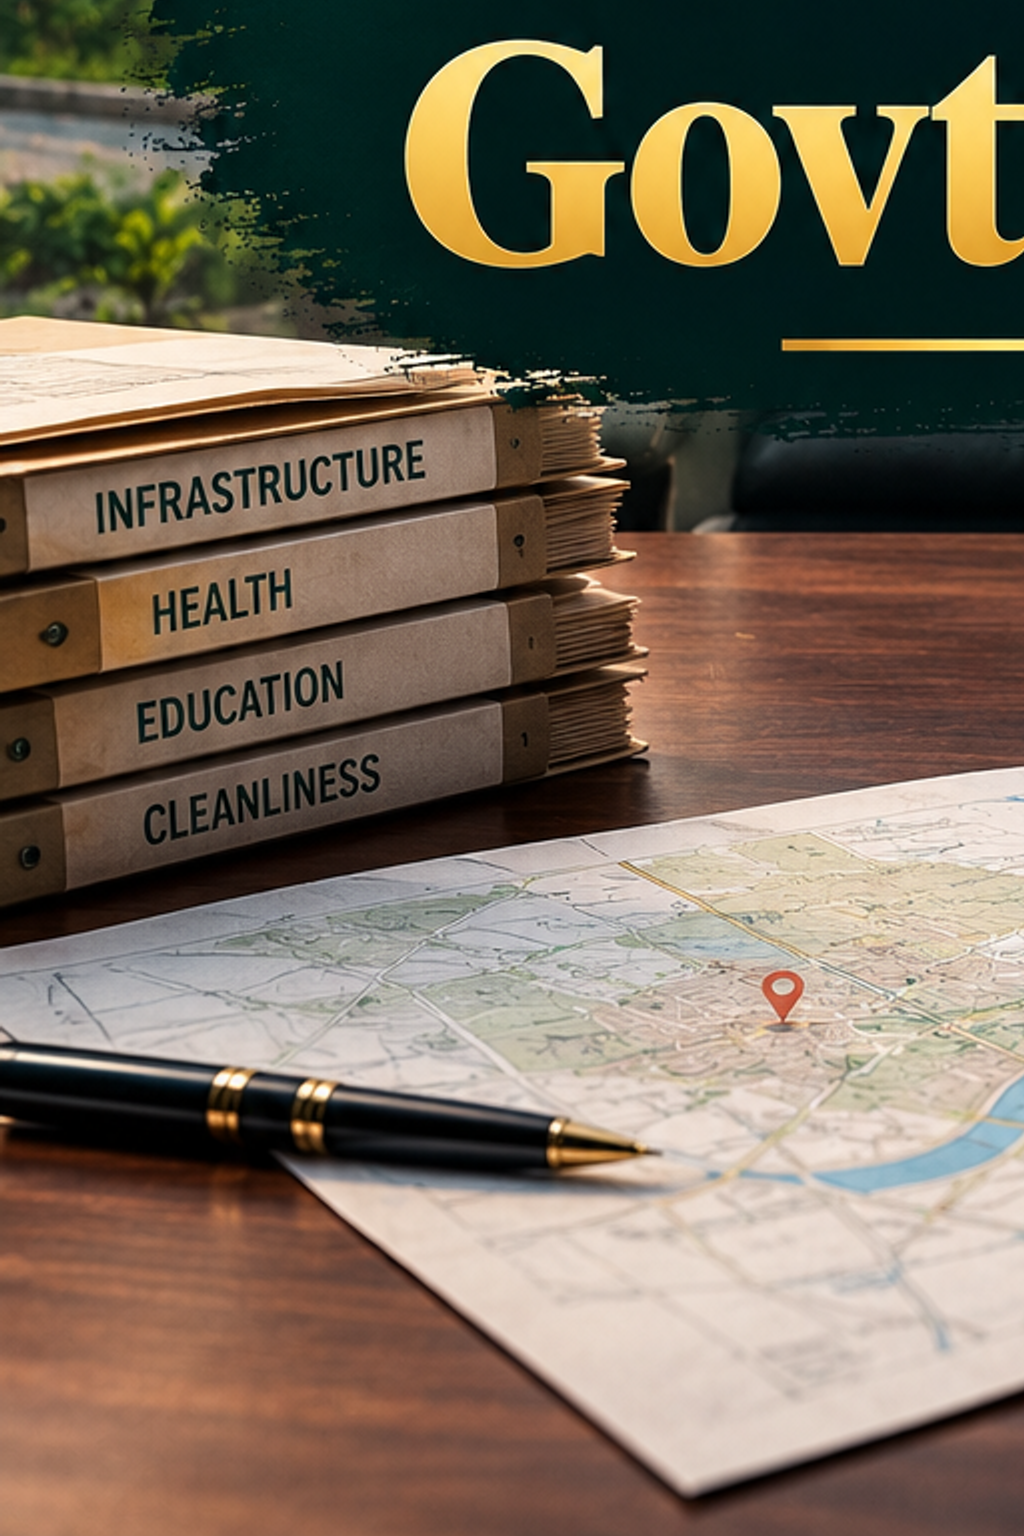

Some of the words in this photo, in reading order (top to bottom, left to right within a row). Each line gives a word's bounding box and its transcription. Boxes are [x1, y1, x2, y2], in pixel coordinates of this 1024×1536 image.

[95, 439, 427, 534] INFRASTRUCTURE
[152, 568, 293, 635] HEALTH
[136, 660, 345, 744] EDUCATION
[143, 753, 381, 846] CLEANLINESS
